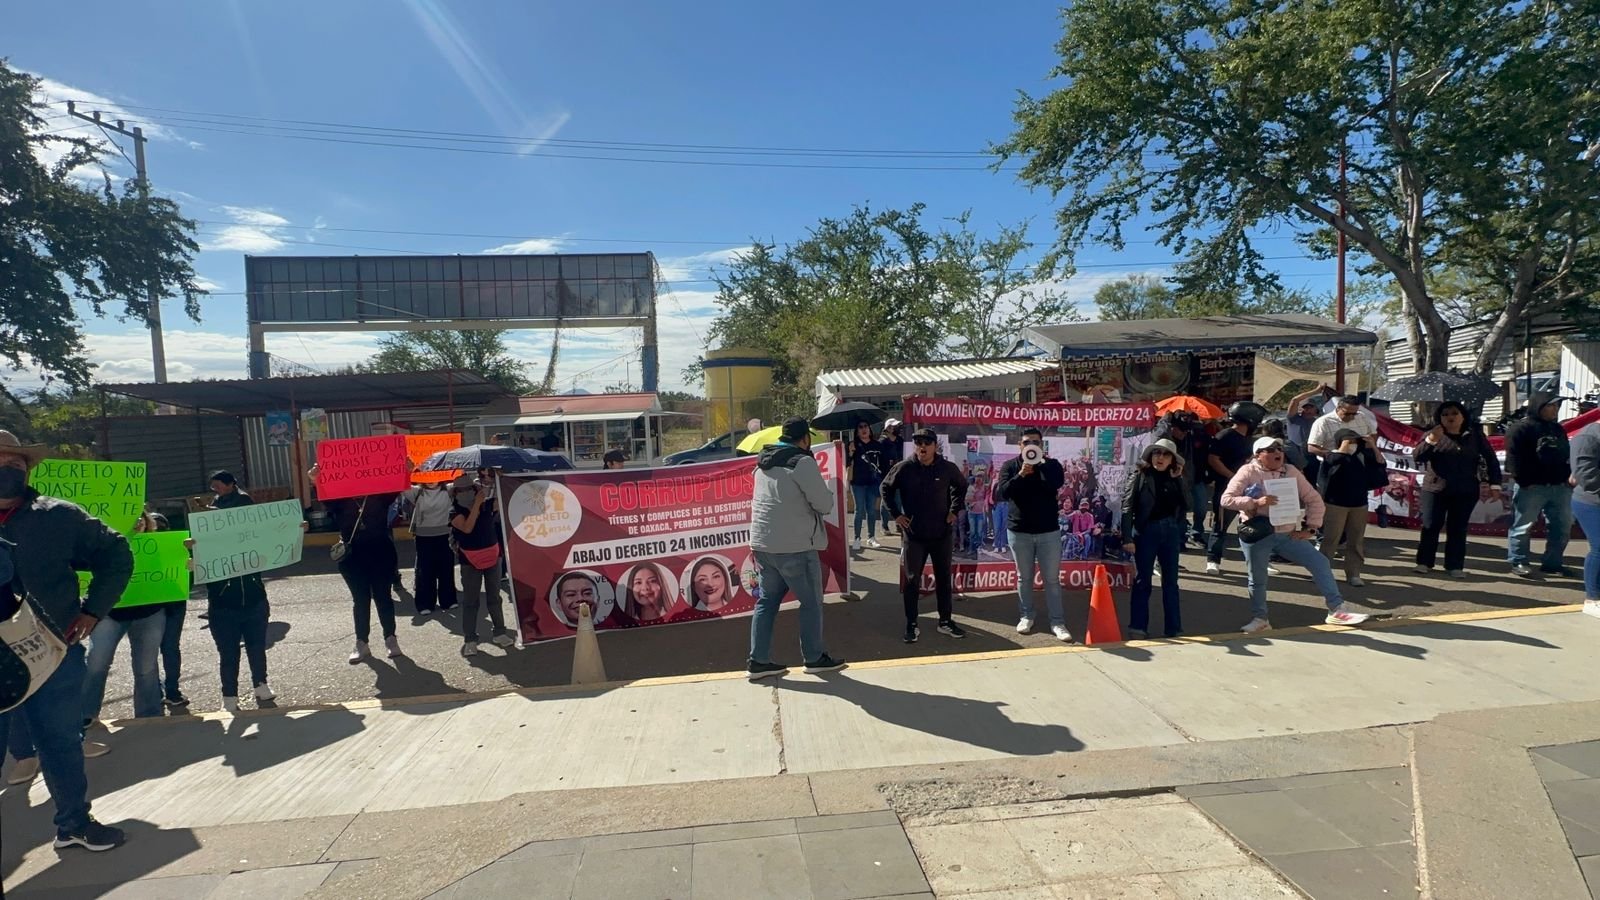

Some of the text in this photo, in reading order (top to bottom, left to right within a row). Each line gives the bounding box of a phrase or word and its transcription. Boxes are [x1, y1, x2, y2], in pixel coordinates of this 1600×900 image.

[912, 402, 1150, 422] MOVIMIENTO EN CONTRA DEL DECRETO 24
[322, 440, 388, 459] DIPUTADO
[1376, 436, 1416, 455] NEPO
[34, 462, 145, 479] DECRETO NO
[319, 455, 371, 471] VENDISTE
[382, 453, 390, 465] Y
[108, 482, 118, 497] Y
[122, 482, 143, 497] AL
[600, 467, 753, 513] CORRUPTOS
[121, 502, 139, 516] TE
[522, 511, 569, 524] DECRETO
[608, 500, 753, 526] TÍTERES Y COMPLICES DE LA DESTRUCC
[524, 523, 548, 540] 24
[628, 512, 747, 536] DE OAXACA, PERROS DEL PATRÓN
[238, 530, 260, 543] DEL
[572, 547, 612, 565] ABAJO
[615, 541, 667, 560] DECRETO
[670, 537, 687, 552] 24
[195, 550, 260, 582] DECRETO
[951, 570, 1017, 590] ICIEMBRE
